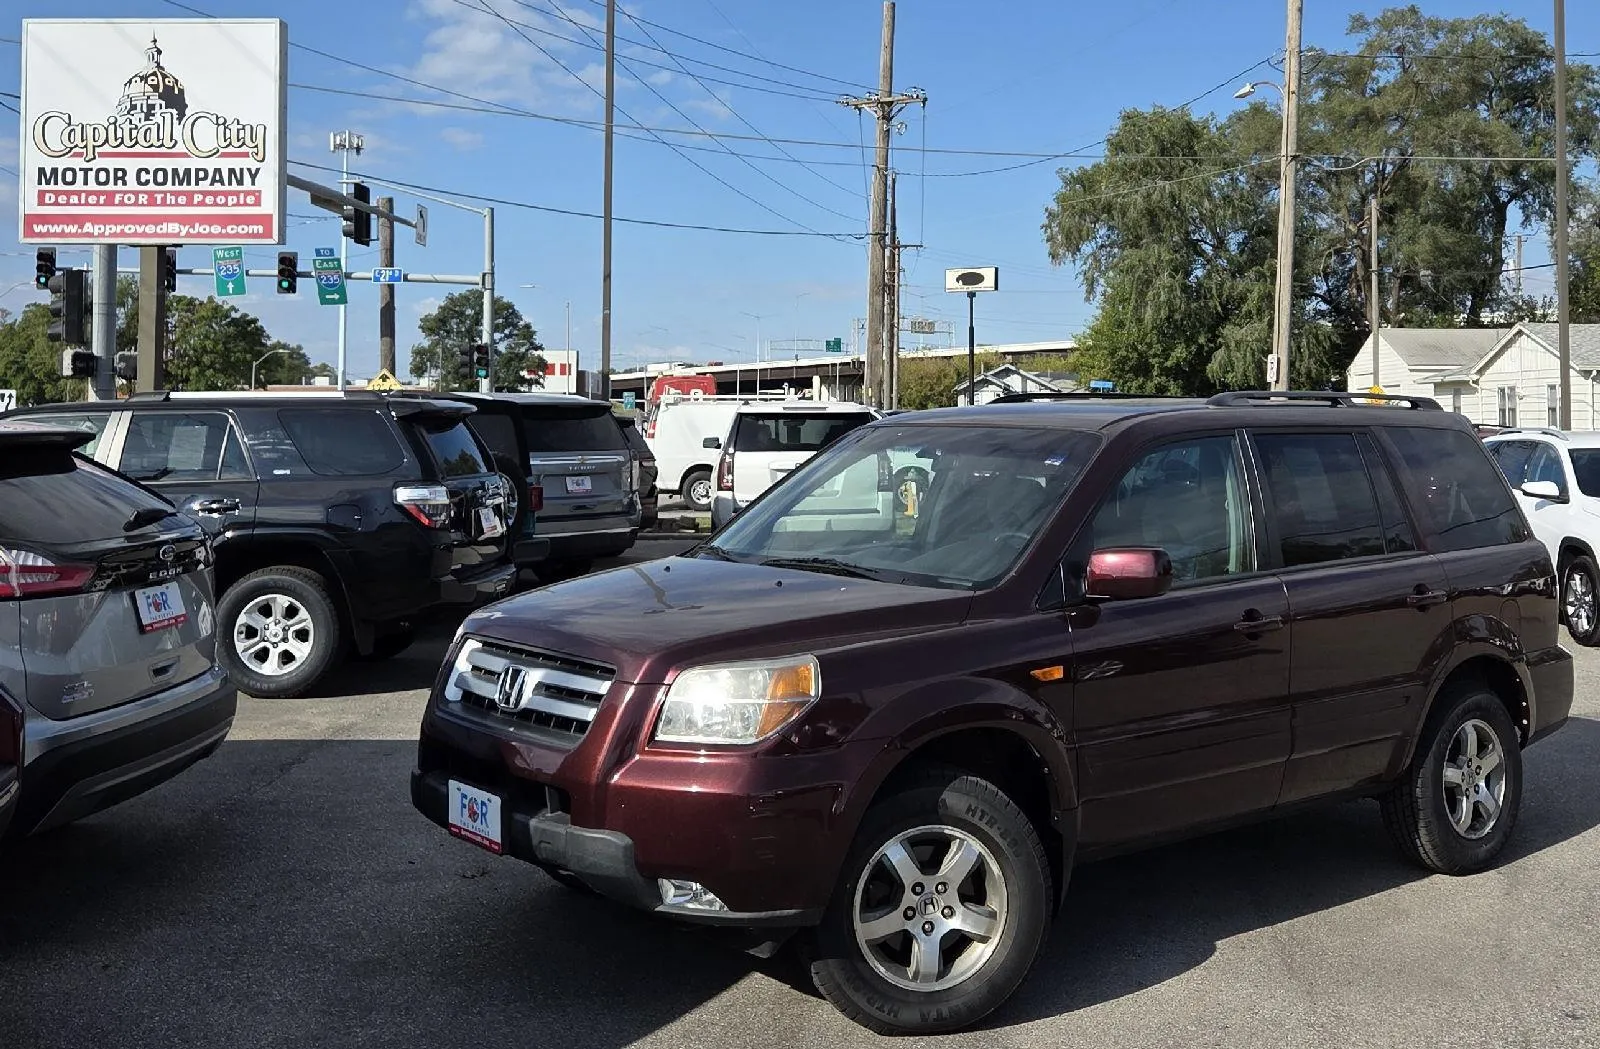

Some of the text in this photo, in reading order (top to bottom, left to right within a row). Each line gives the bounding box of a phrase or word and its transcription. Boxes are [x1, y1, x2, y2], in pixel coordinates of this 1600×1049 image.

[33, 111, 266, 162] Capital City
[37, 167, 261, 186] MOTOR COMPANY
[44, 192, 106, 205] Dealer
[114, 193, 148, 205] FOR
[154, 193, 187, 205] The
[33, 222, 263, 236] www.ApprovedByJoe.com
[220, 264, 240, 276] 235
[320, 274, 340, 284] 235
[145, 591, 172, 615] FOR
[460, 792, 489, 828] FOR
